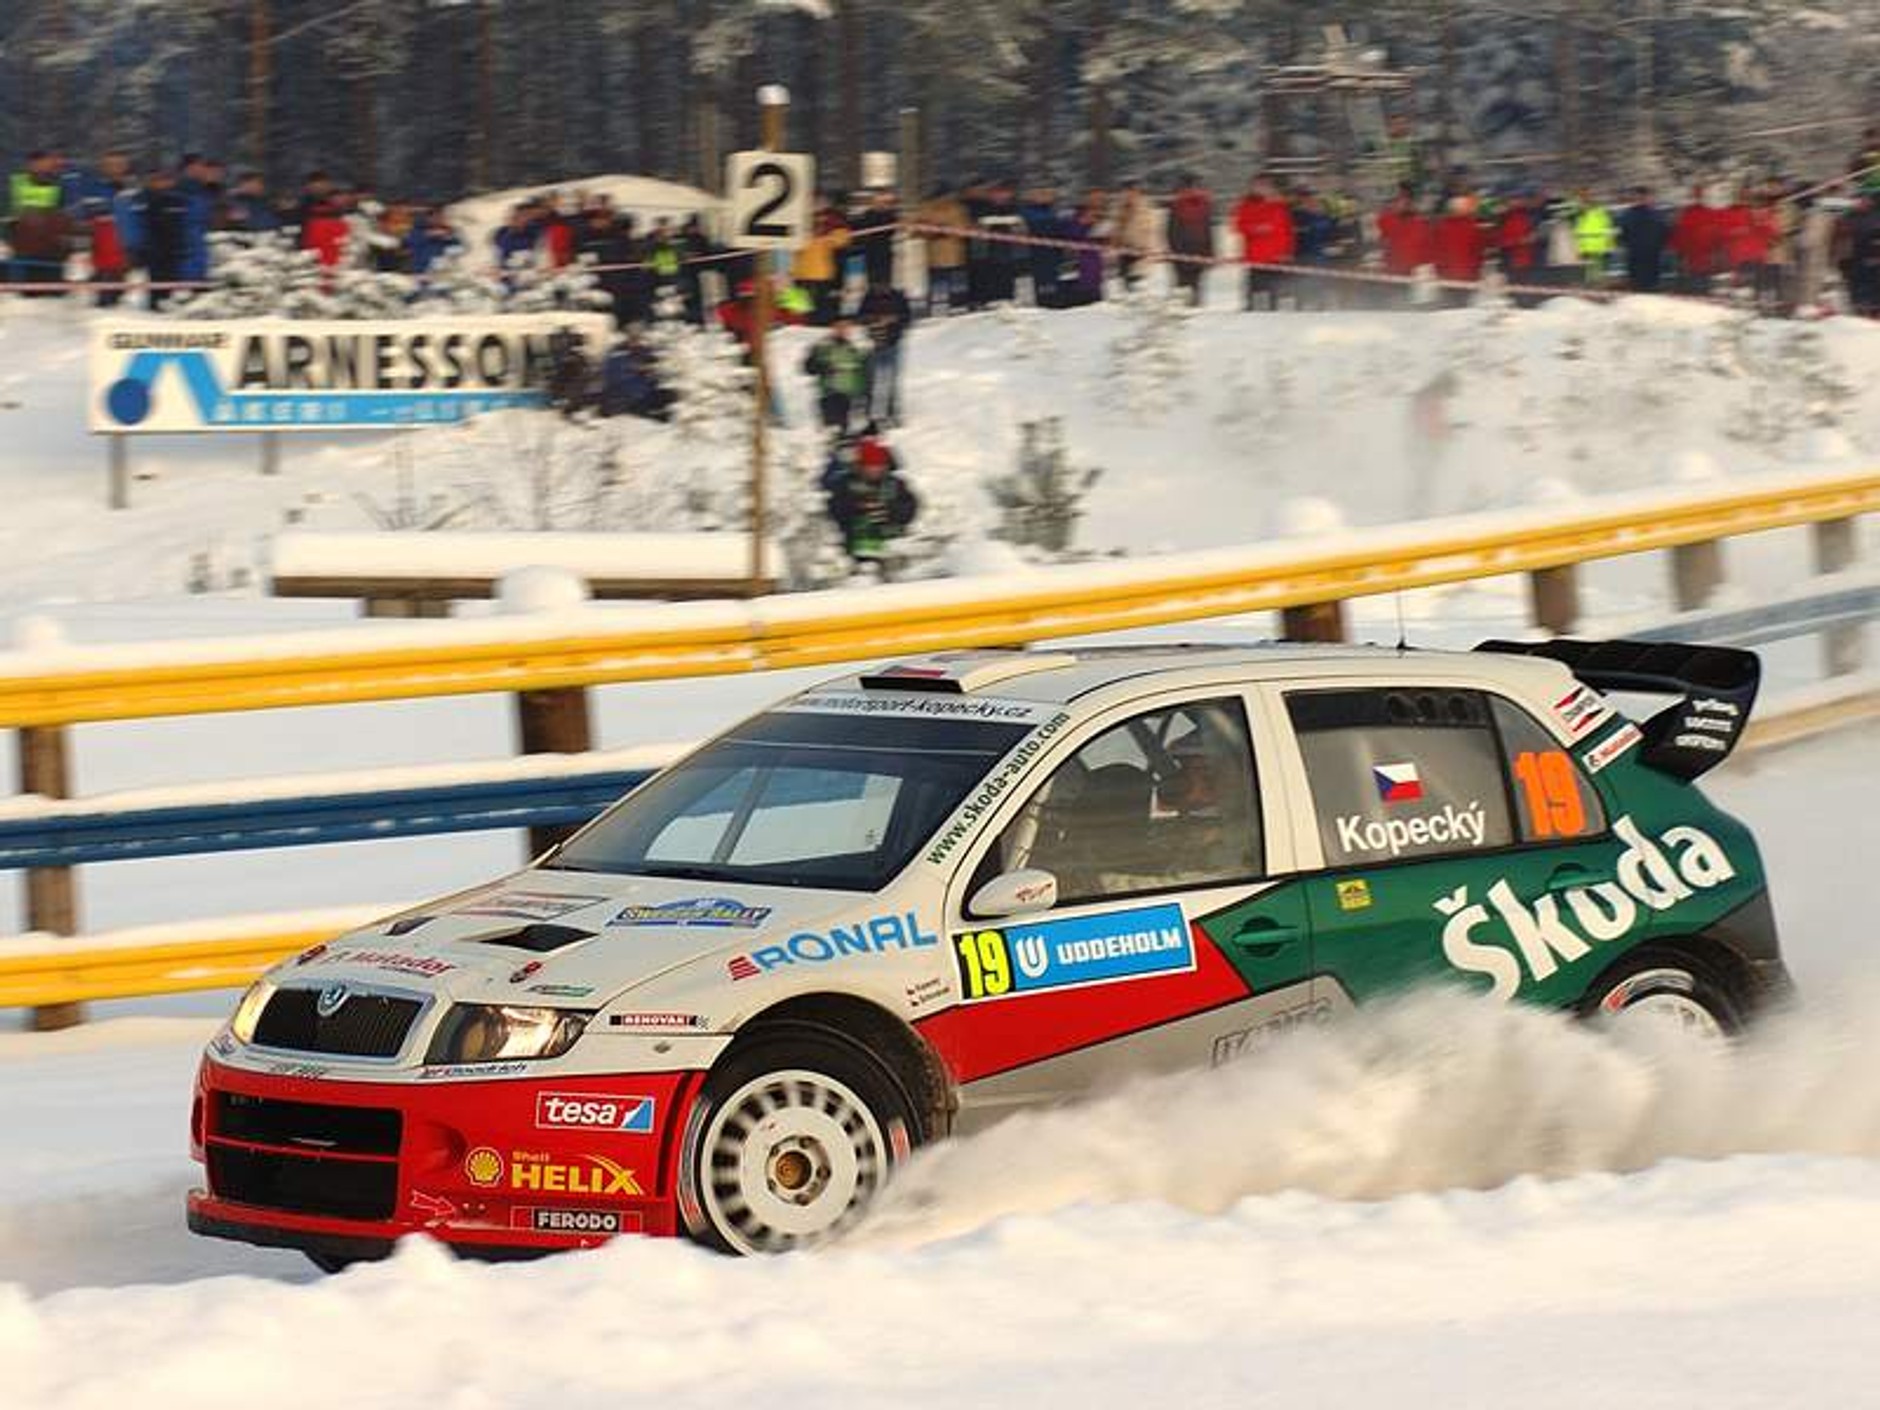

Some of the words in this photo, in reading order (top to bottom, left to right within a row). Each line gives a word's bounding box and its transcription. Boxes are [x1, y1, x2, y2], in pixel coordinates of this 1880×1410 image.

[746, 162, 791, 236] 2
[926, 711, 1071, 866] www.skoda-auto.com
[1513, 751, 1587, 838] 19
[1335, 800, 1486, 855] Kopecký
[1432, 815, 1736, 1001] Škoda
[752, 912, 939, 971] RONAL
[958, 929, 1010, 998] 19
[1056, 927, 1183, 965] UDDEHOLM
[544, 1097, 618, 1125] tesa
[511, 1156, 644, 1196] HELIX
[537, 1212, 618, 1230] FERODO
